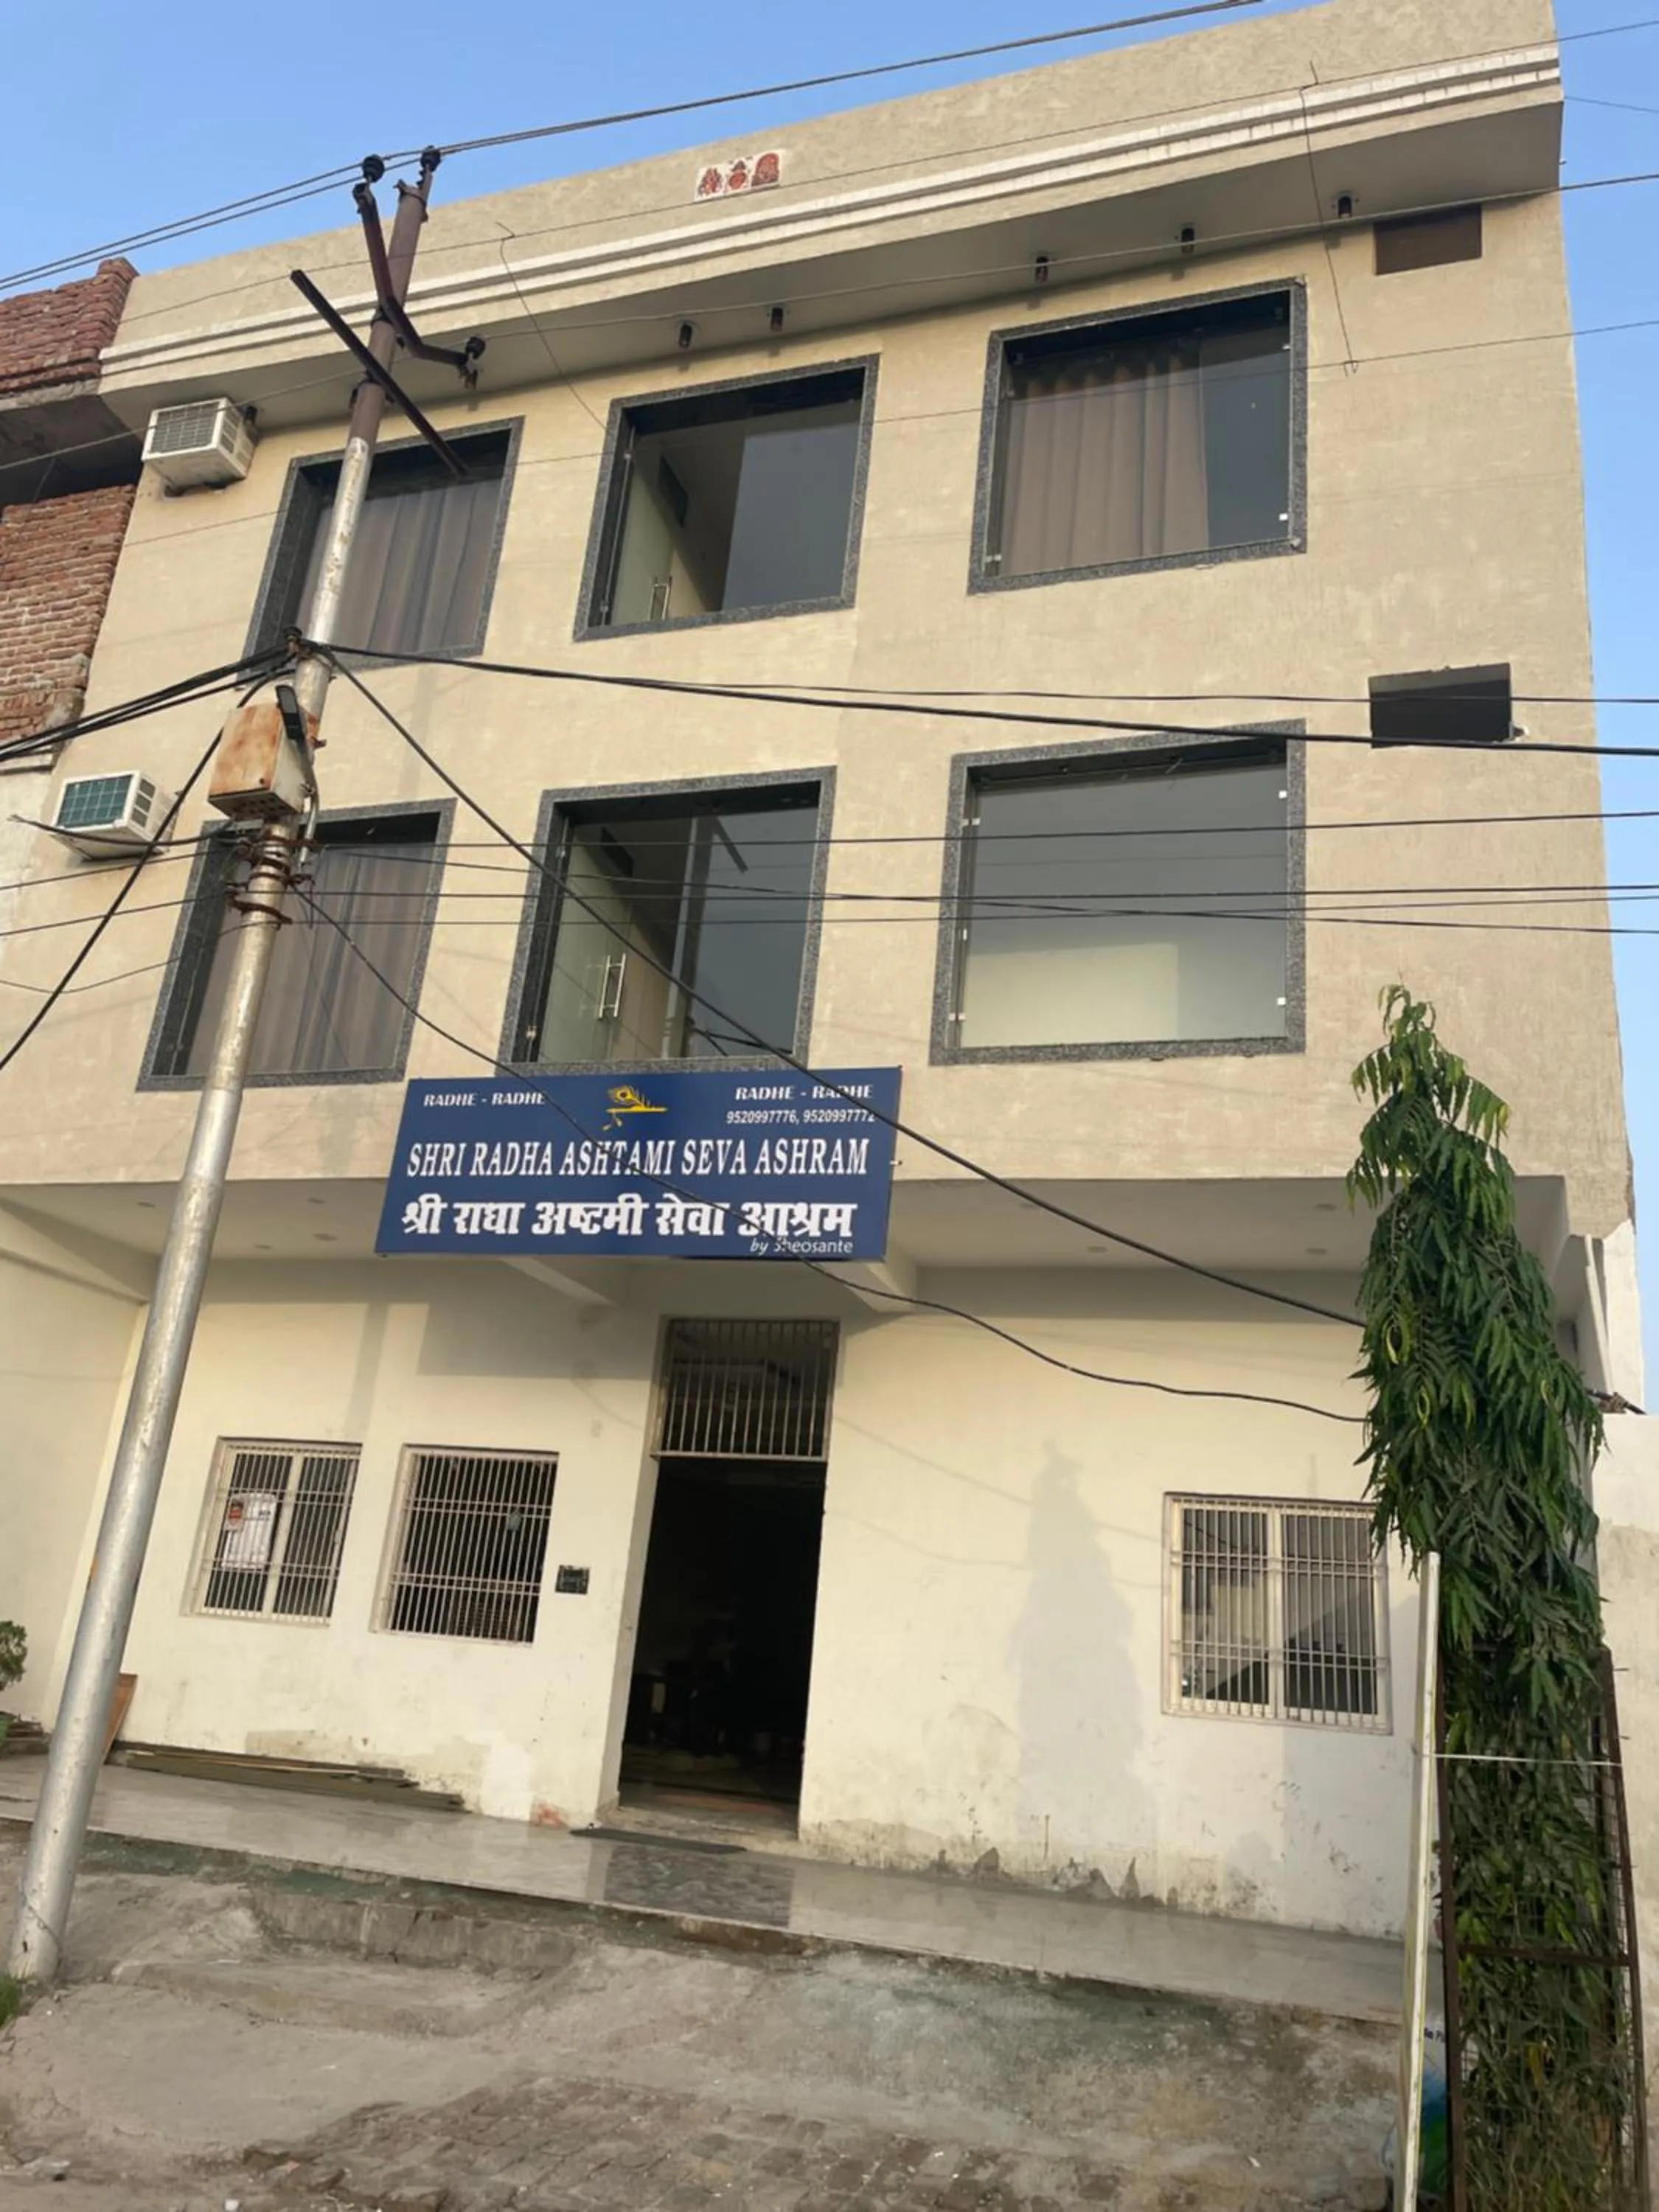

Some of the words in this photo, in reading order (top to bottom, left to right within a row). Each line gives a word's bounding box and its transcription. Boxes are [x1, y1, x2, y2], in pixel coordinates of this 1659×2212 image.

[423, 1093, 477, 1106] RADHE
[491, 1091, 546, 1105] RADHE
[735, 1085, 796, 1100] RADHE
[812, 1084, 874, 1099] RADHE
[407, 1142, 466, 1177] SHRI
[469, 1141, 552, 1176] RADHA
[558, 1139, 676, 1177] ASHTAMI
[681, 1138, 747, 1176] SEVA
[753, 1137, 871, 1176] ASHRAM
[401, 1192, 448, 1235] श्री
[531, 1192, 650, 1236] अष्टमी
[654, 1192, 731, 1236] सेवा
[737, 1201, 858, 1237] आश्रम
[750, 1238, 768, 1256] by
